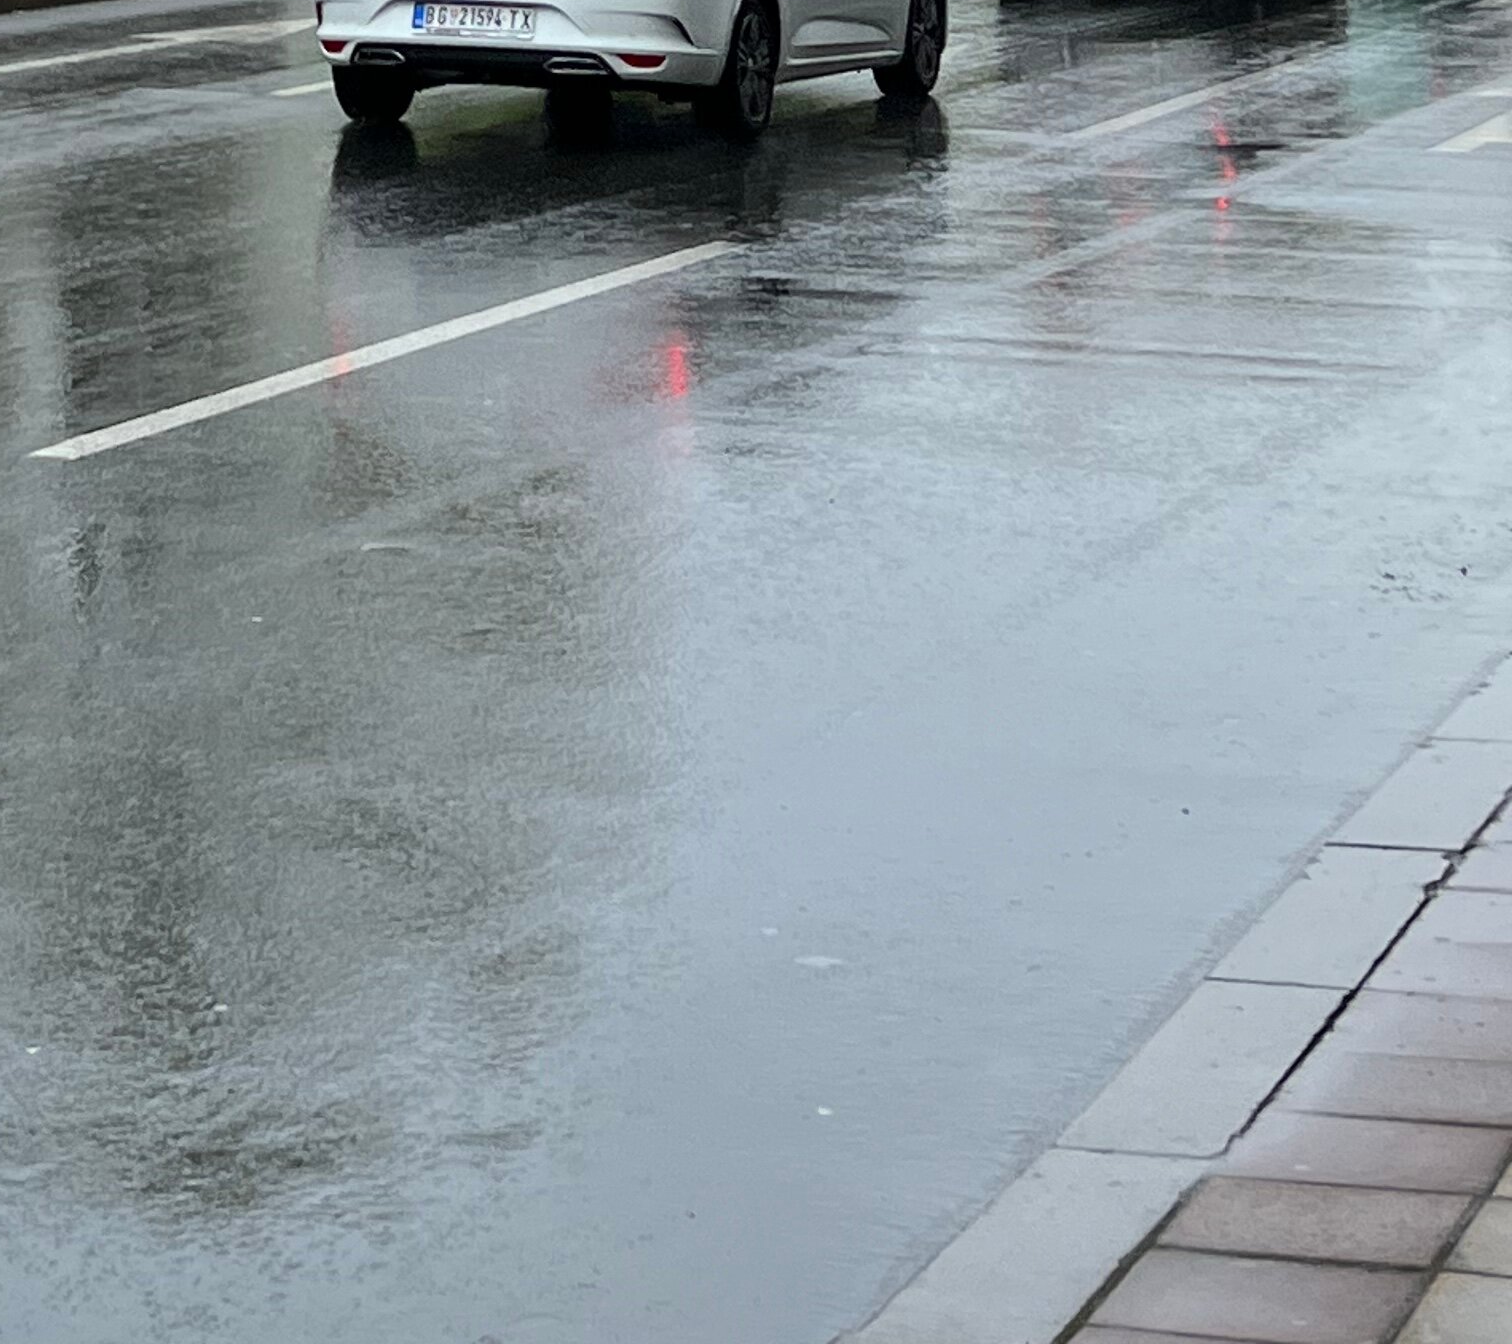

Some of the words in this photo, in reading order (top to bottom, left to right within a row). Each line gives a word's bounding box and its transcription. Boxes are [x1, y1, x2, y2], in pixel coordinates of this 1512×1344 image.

[426, 5, 447, 25] BG
[459, 7, 502, 27] 21594
[510, 9, 531, 29] TX
